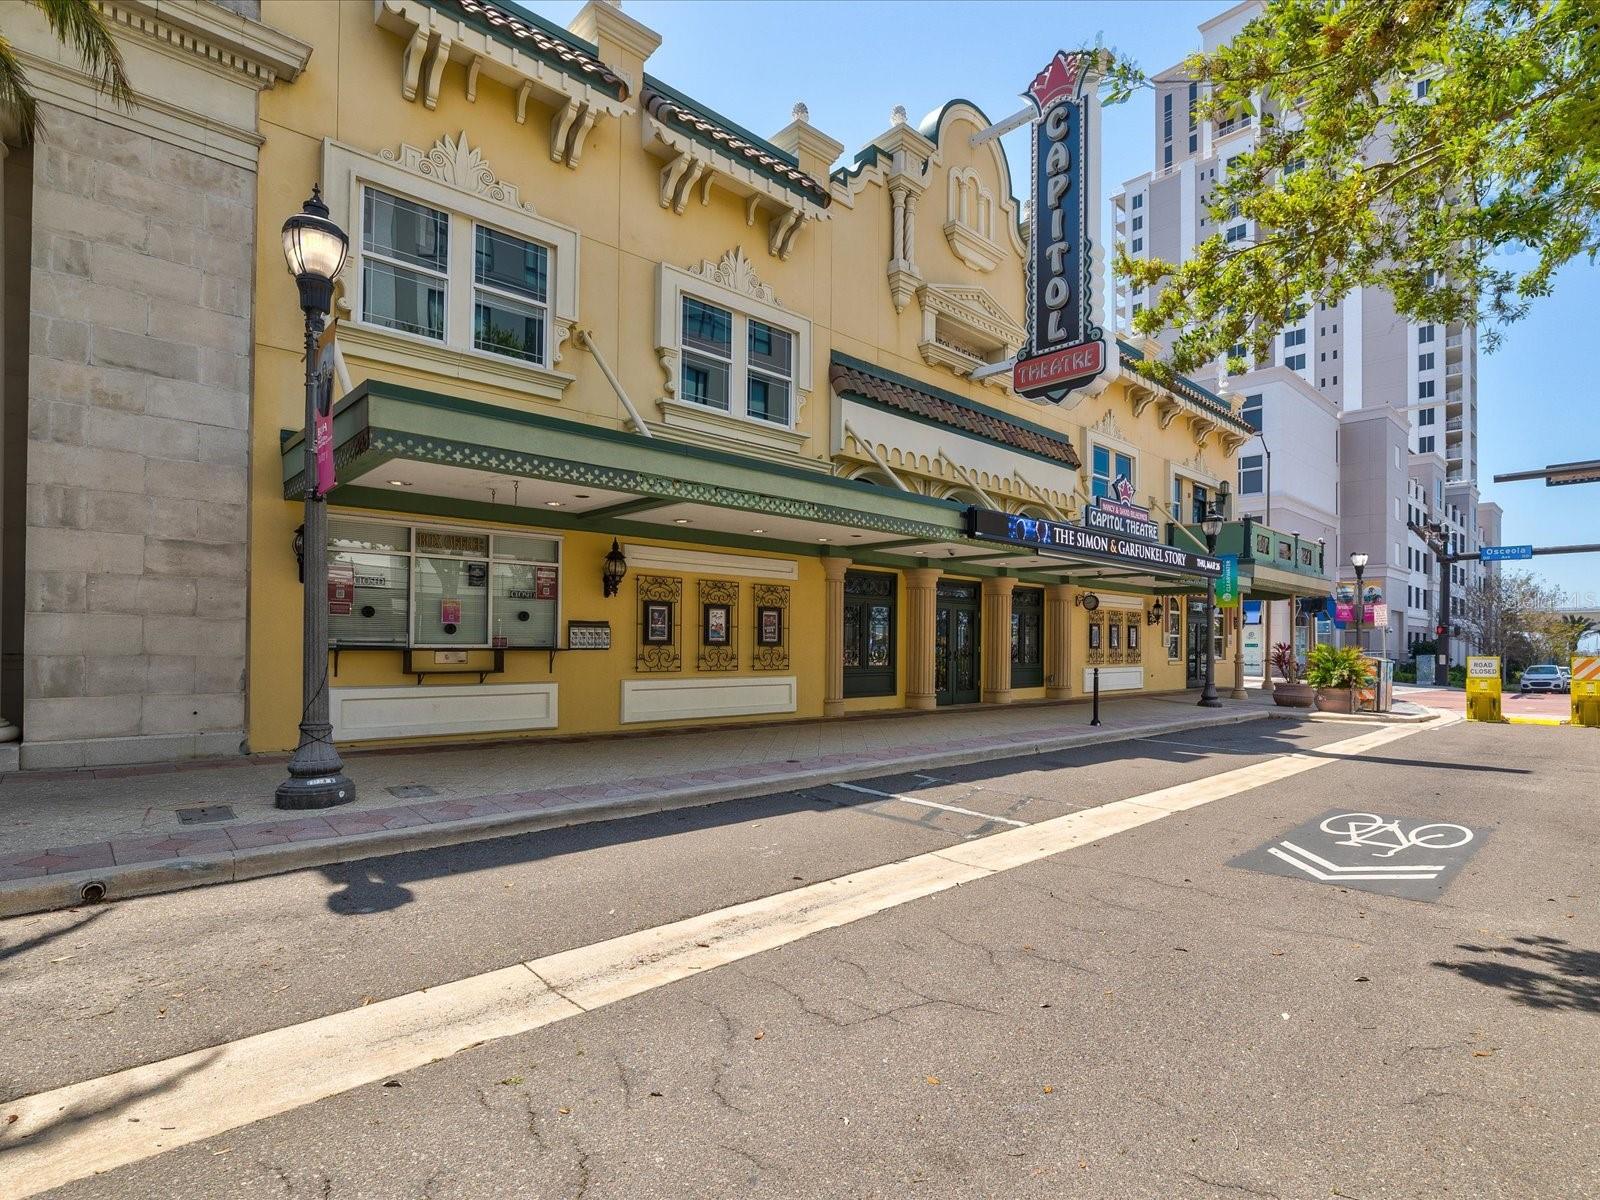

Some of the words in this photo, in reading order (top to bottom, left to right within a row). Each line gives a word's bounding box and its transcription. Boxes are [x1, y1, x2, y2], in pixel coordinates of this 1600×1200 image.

[1045, 106, 1070, 343] CAPITOL
[1018, 349, 1094, 384] THEATRE
[1090, 510, 1125, 532] CAPITOL
[1125, 519, 1158, 540] THEATRE
[1053, 527, 1075, 546] THE
[1076, 532, 1108, 552] SIMON
[1110, 539, 1117, 554] &
[1118, 541, 1164, 563] GARFUNKEL
[1164, 551, 1187, 567] STORY
[1486, 547, 1526, 555] Osceola
